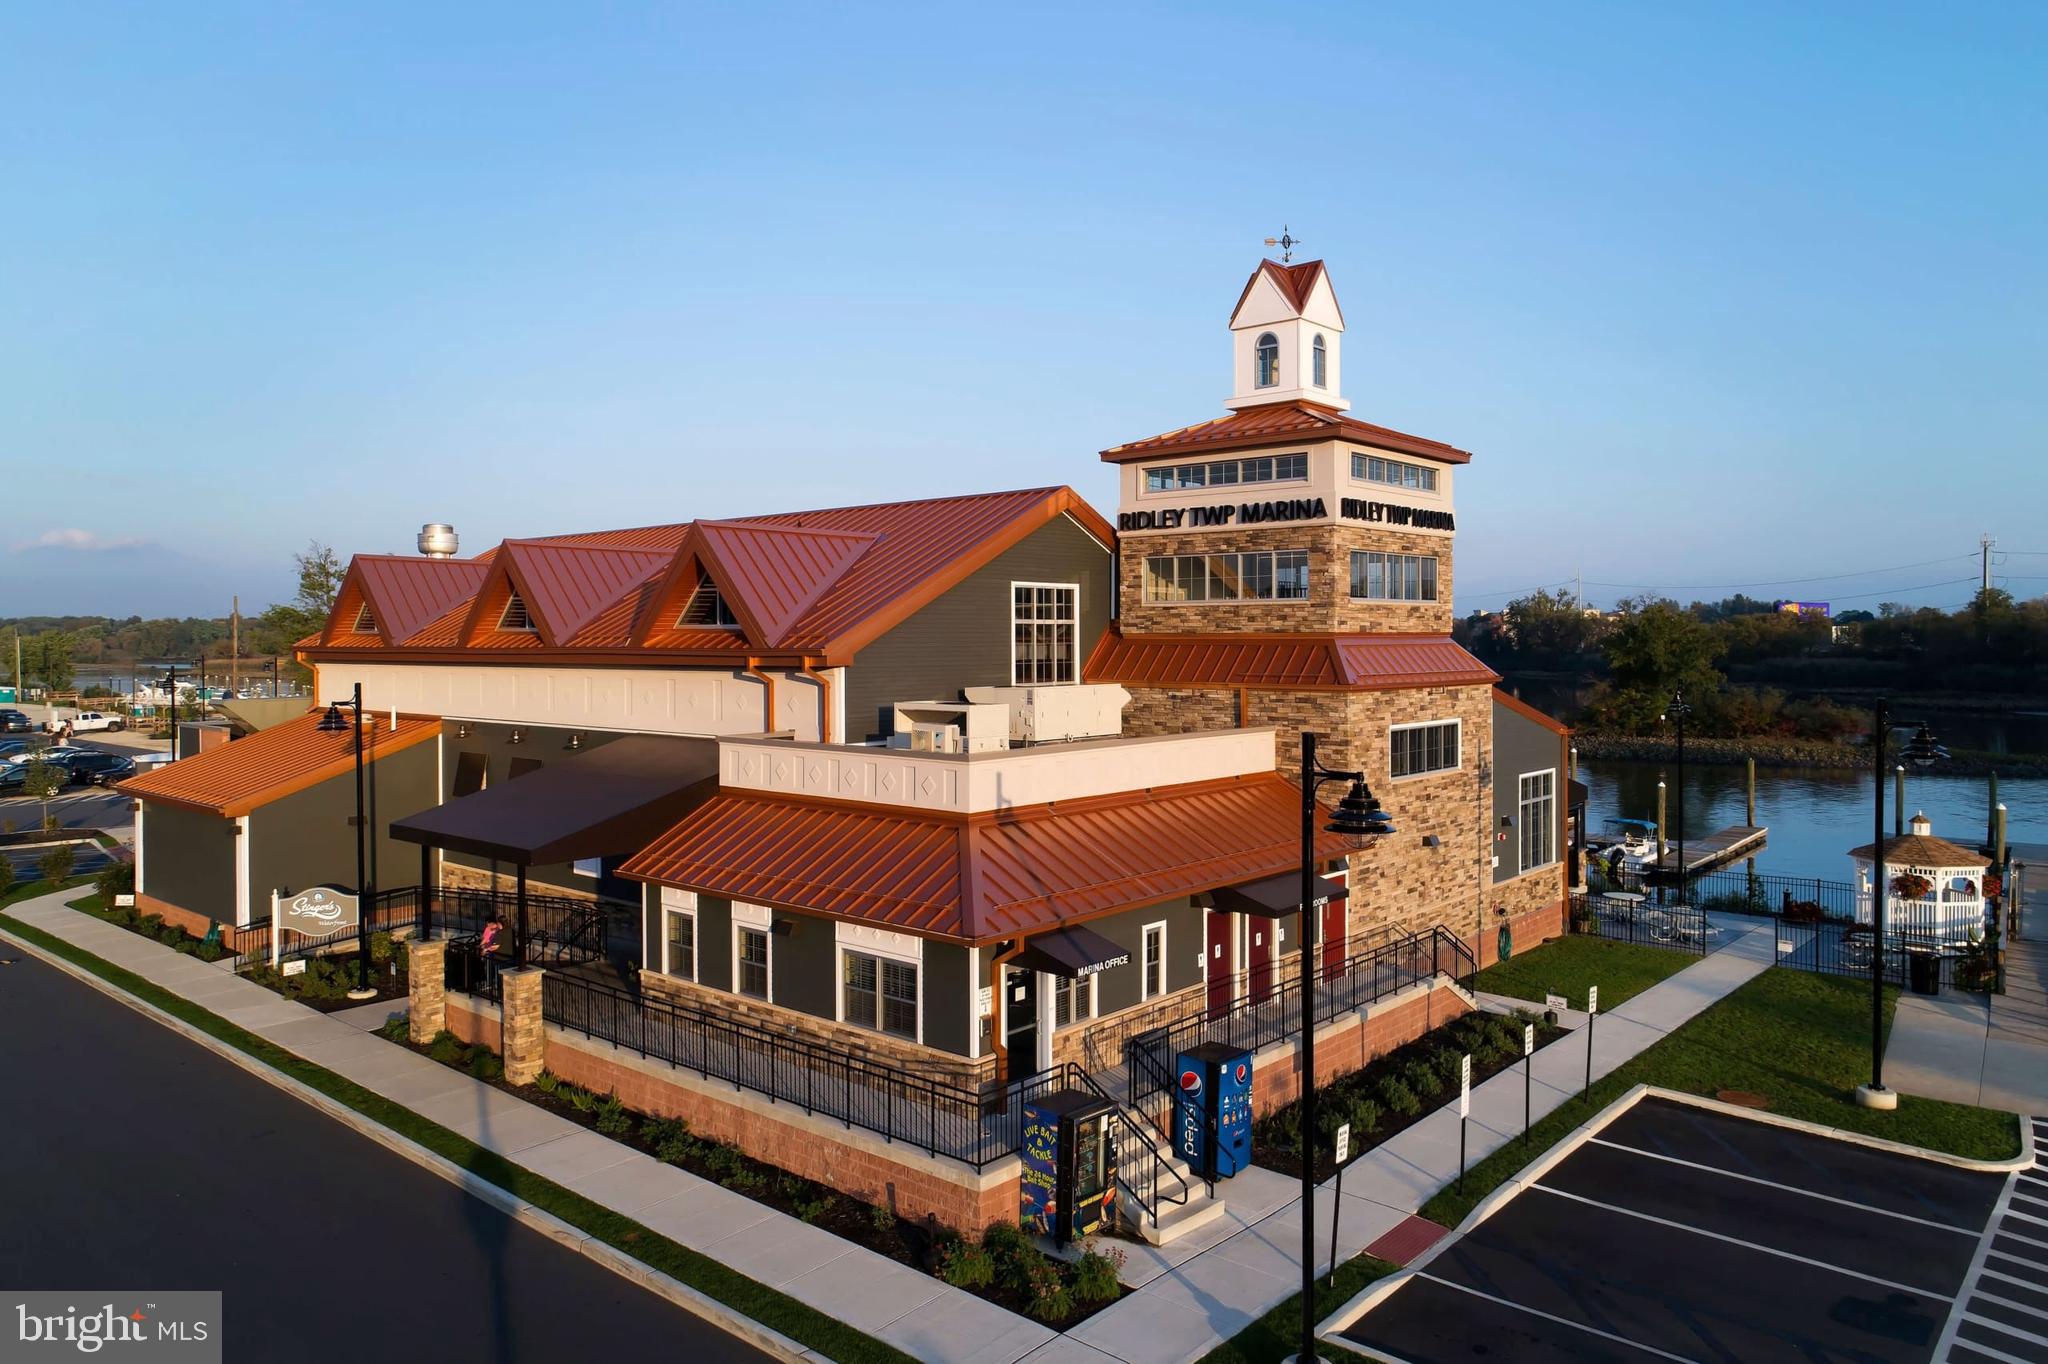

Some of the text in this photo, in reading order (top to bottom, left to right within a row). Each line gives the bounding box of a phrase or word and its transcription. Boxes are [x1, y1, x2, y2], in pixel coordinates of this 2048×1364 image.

[1119, 498, 1328, 531] RIDLEY TWP MARINA
[1341, 498, 1455, 531] RIDLEY TWP MARINA
[1077, 955, 1129, 977] MARINA OFFICE
[1024, 1124, 1057, 1146] LIVE BAIT
[1026, 1142, 1053, 1161] TACKLE
